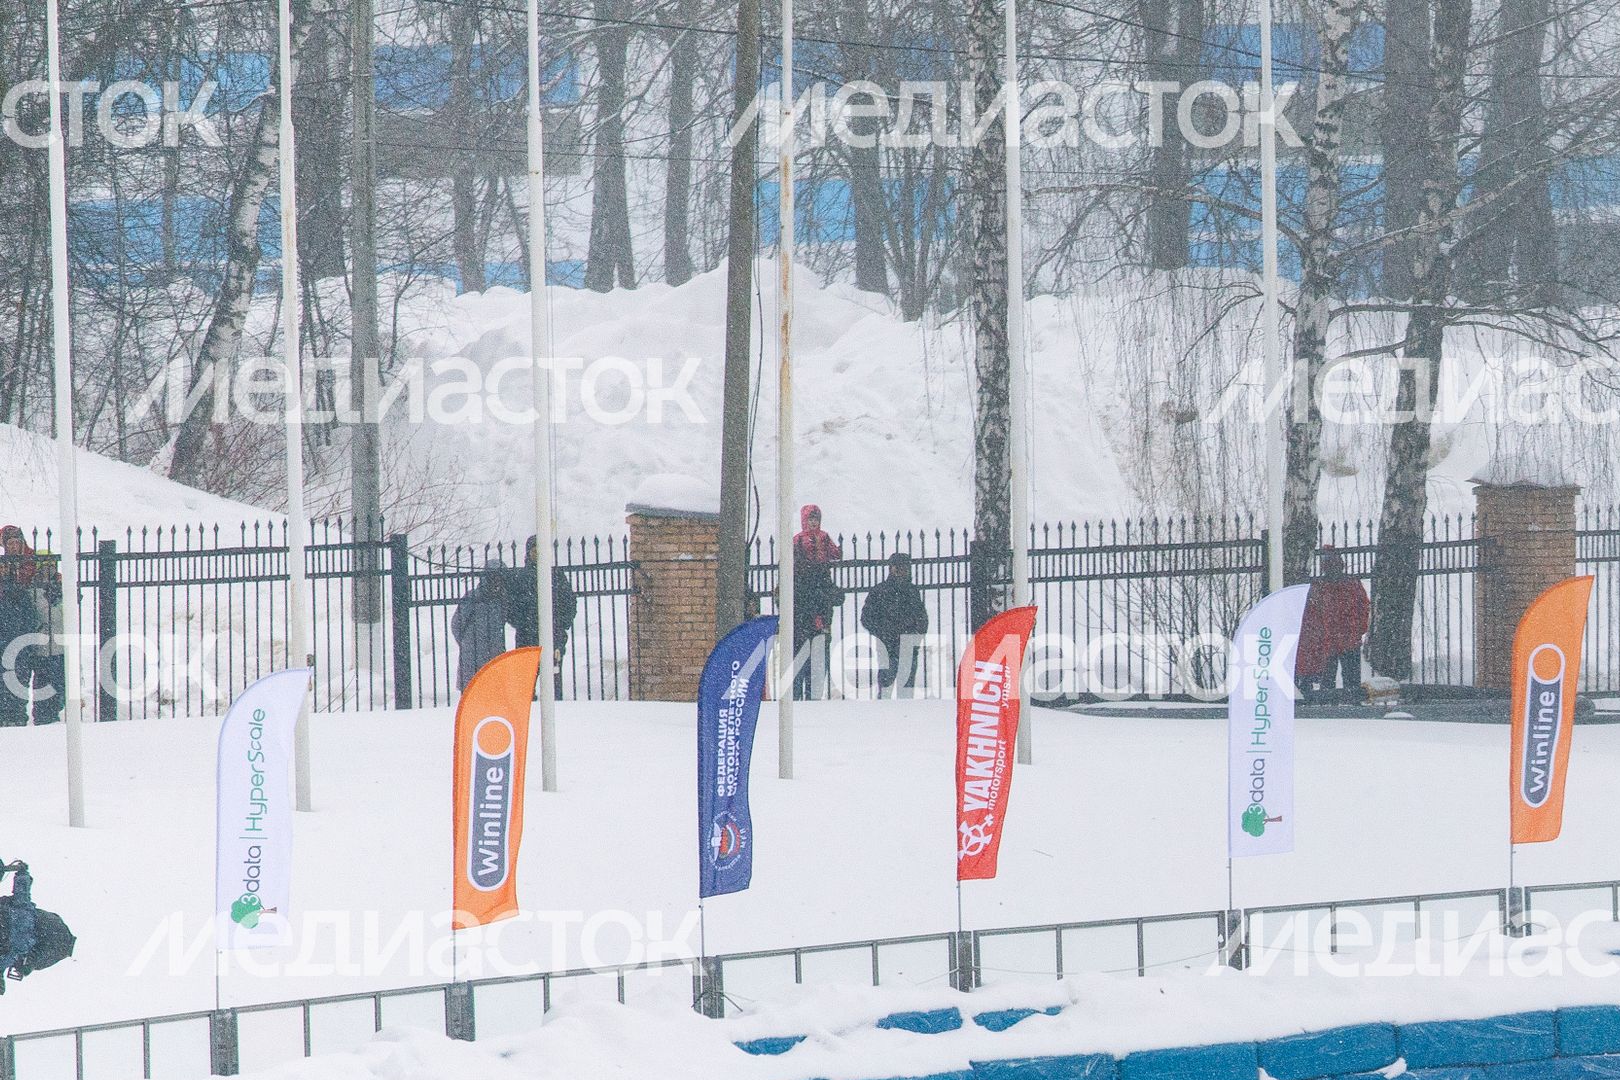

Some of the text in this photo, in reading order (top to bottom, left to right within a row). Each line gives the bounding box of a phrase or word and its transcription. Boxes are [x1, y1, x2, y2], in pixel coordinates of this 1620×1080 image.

[735, 678, 749, 736] РОССИИ
[962, 660, 1004, 813] YAKHNICH
[716, 708, 728, 797] ФЕДЕРАЦИЯ
[986, 738, 1007, 811] motorsport
[1247, 758, 1266, 815] 3data
[240, 845, 262, 907] 3data
